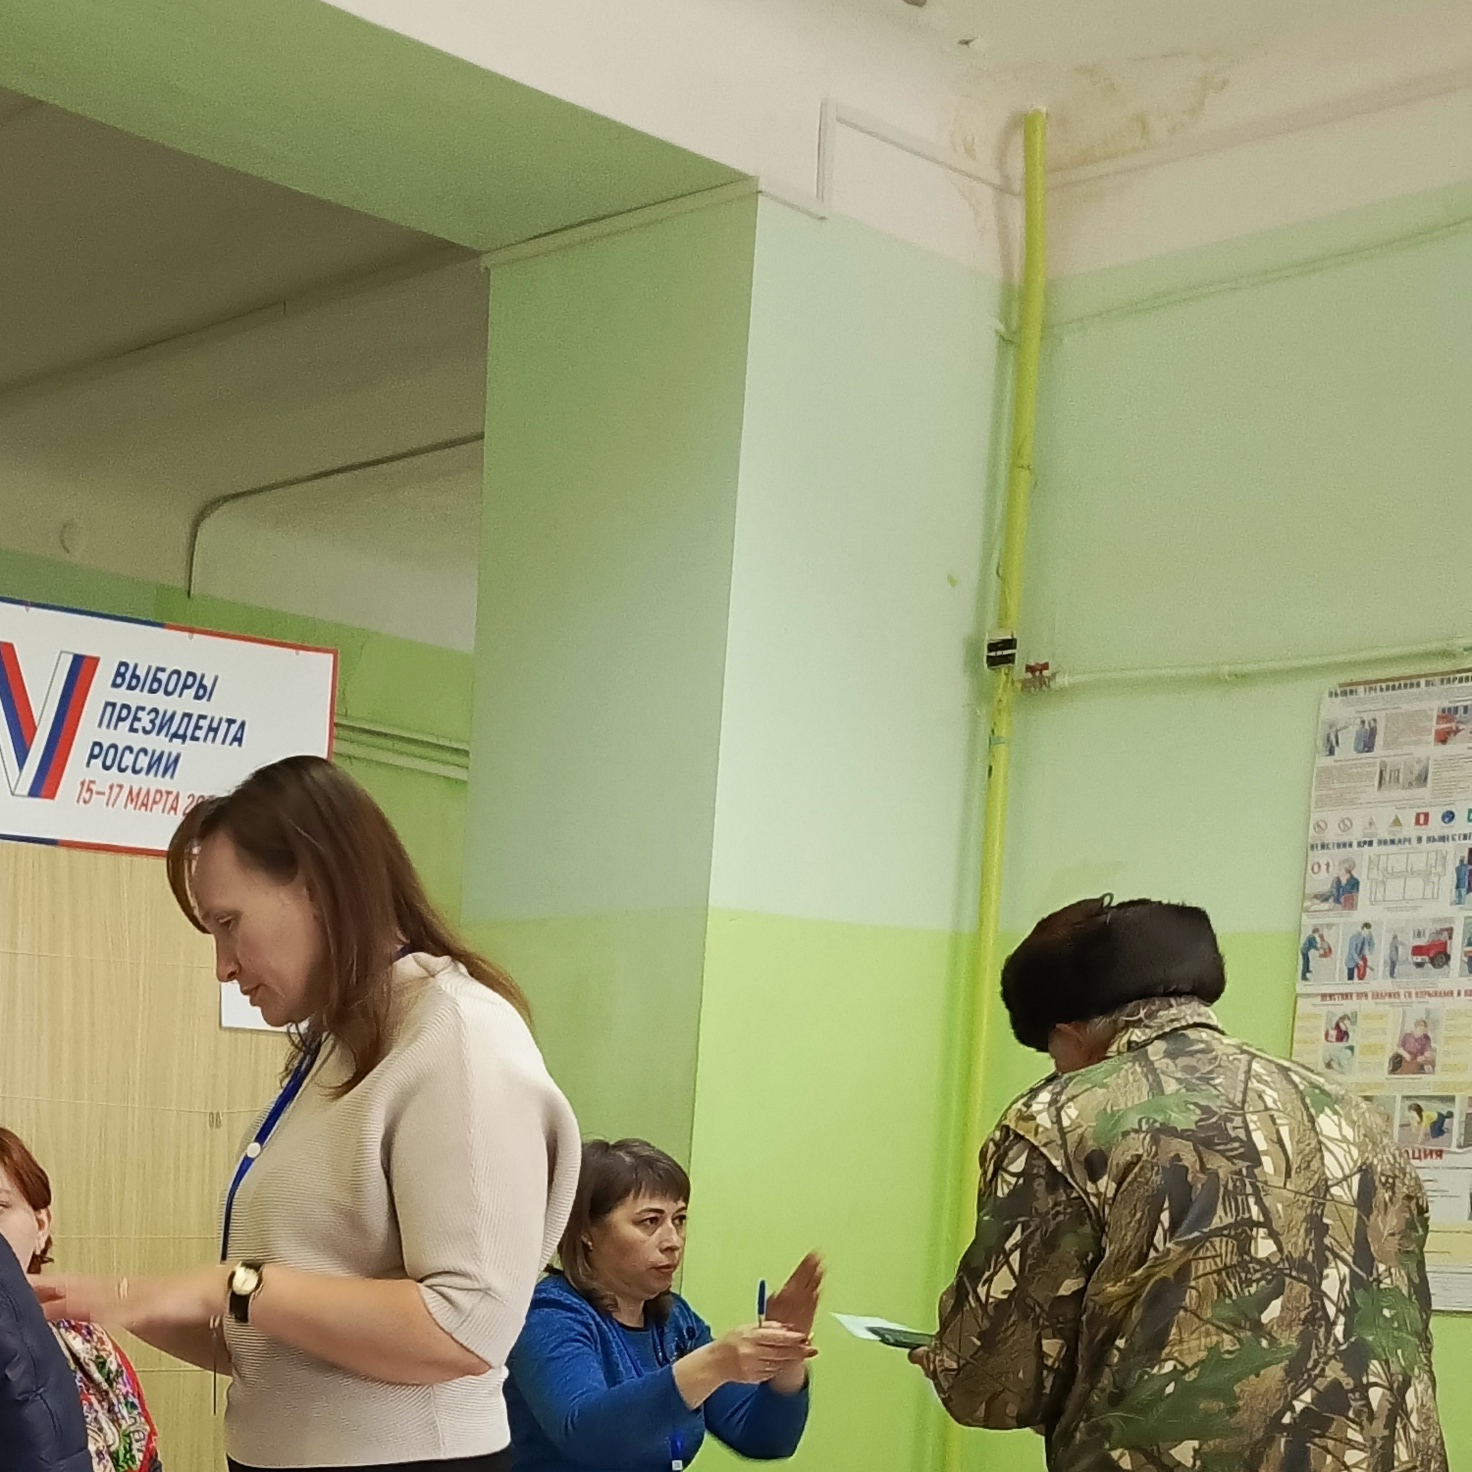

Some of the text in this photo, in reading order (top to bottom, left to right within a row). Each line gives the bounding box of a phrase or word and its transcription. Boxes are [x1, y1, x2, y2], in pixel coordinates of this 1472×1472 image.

[110, 660, 219, 702] ВЫБОРЫ
[97, 701, 246, 748] ПРЕЗИДЕНТА
[86, 741, 181, 780] РОССИИ
[124, 785, 180, 817] МАРТА
